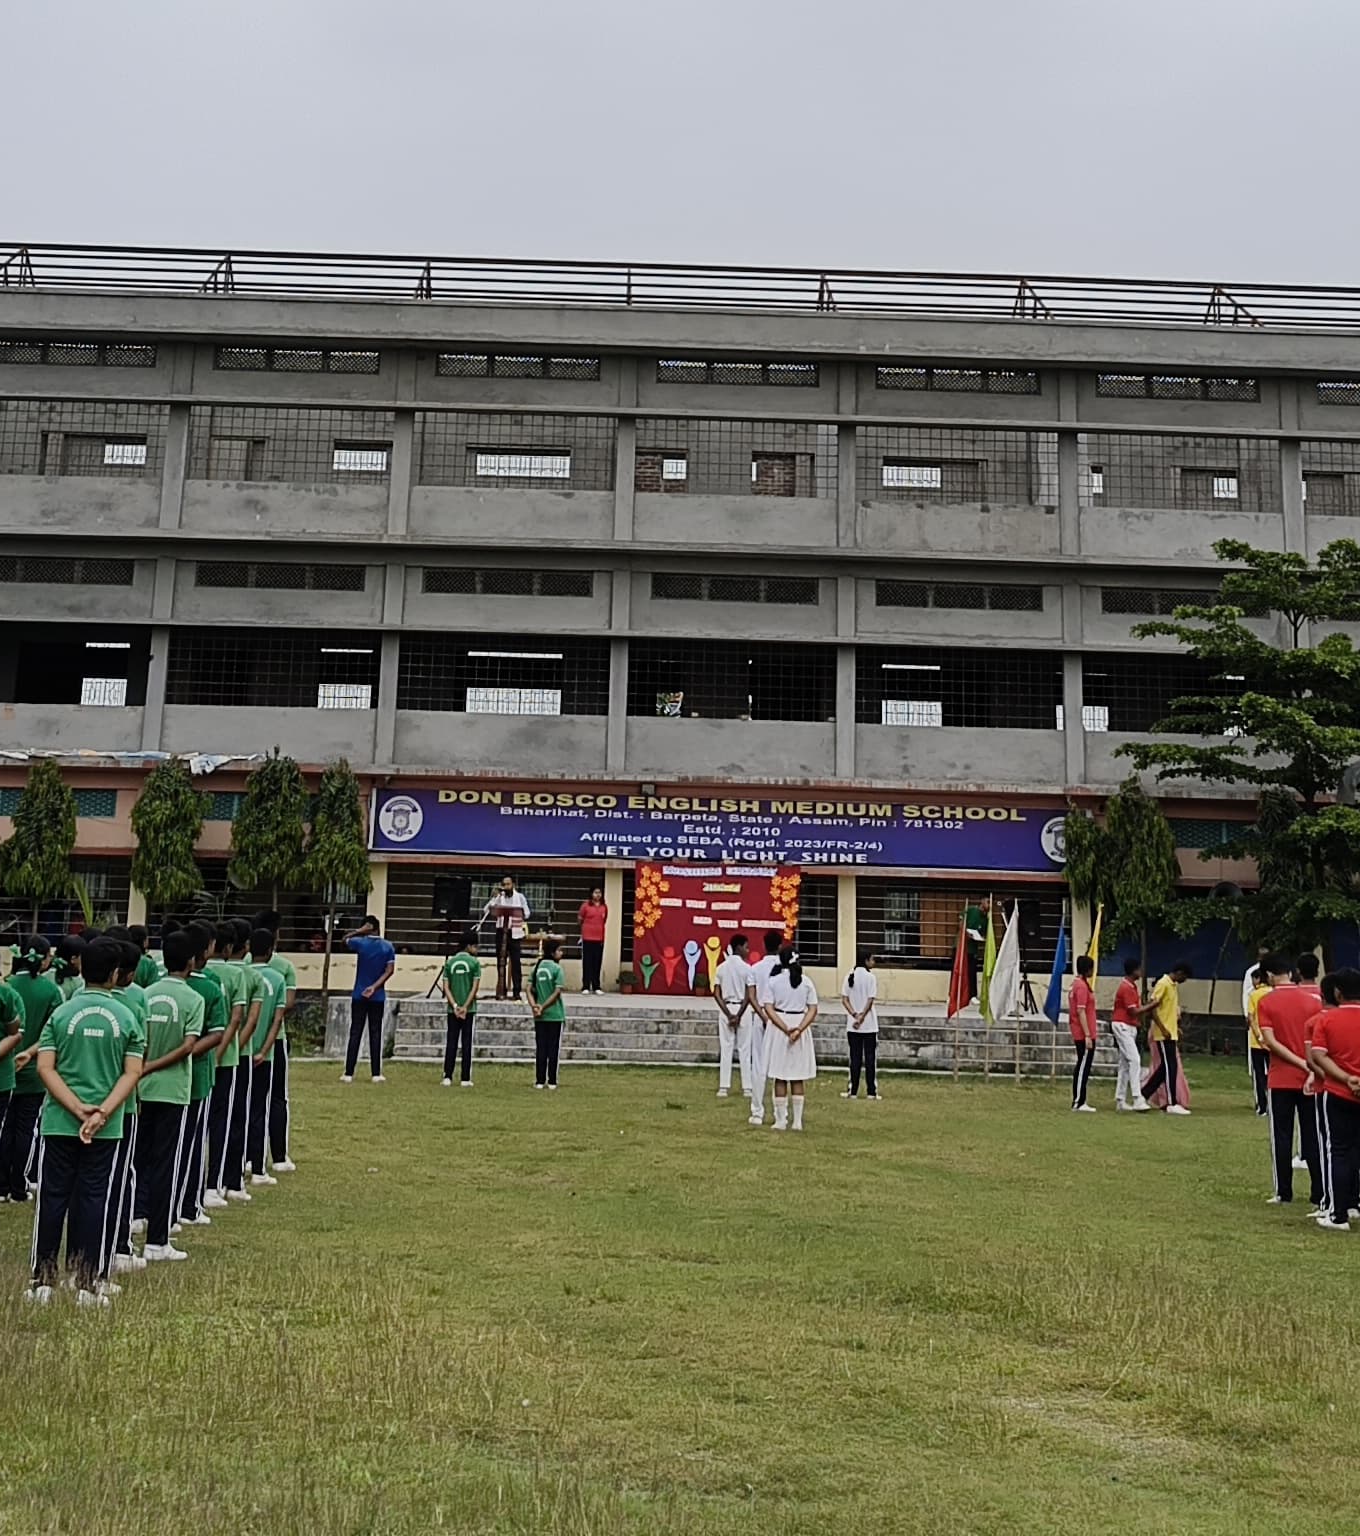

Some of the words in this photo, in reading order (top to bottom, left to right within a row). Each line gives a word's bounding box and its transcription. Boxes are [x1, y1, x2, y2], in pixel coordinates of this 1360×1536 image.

[438, 789, 502, 804] DON
[513, 792, 617, 808] BOSCO
[628, 796, 760, 813] ENGLISH
[771, 801, 892, 817] MEDIUM
[902, 804, 1027, 822] SCHOOL
[500, 806, 589, 819] Baharihat,
[594, 809, 633, 819] Dist.
[650, 811, 722, 823] Barpeta,
[728, 814, 773, 824] State
[788, 816, 854, 827] Assam,
[859, 818, 887, 828] Pin
[903, 819, 964, 830] 781302
[683, 824, 726, 835] Estd.
[741, 827, 781, 836] 2010
[579, 832, 652, 843] Affiliated
[656, 835, 673, 843] to
[677, 836, 724, 846] SEBA
[728, 838, 780, 848] (Regd.
[784, 840, 883, 852] 2023/FR-2/4)
[592, 845, 632, 856] LET
[645, 847, 707, 859] YOUR
[721, 849, 788, 861] LIGHT
[801, 852, 868, 864] SHINE
